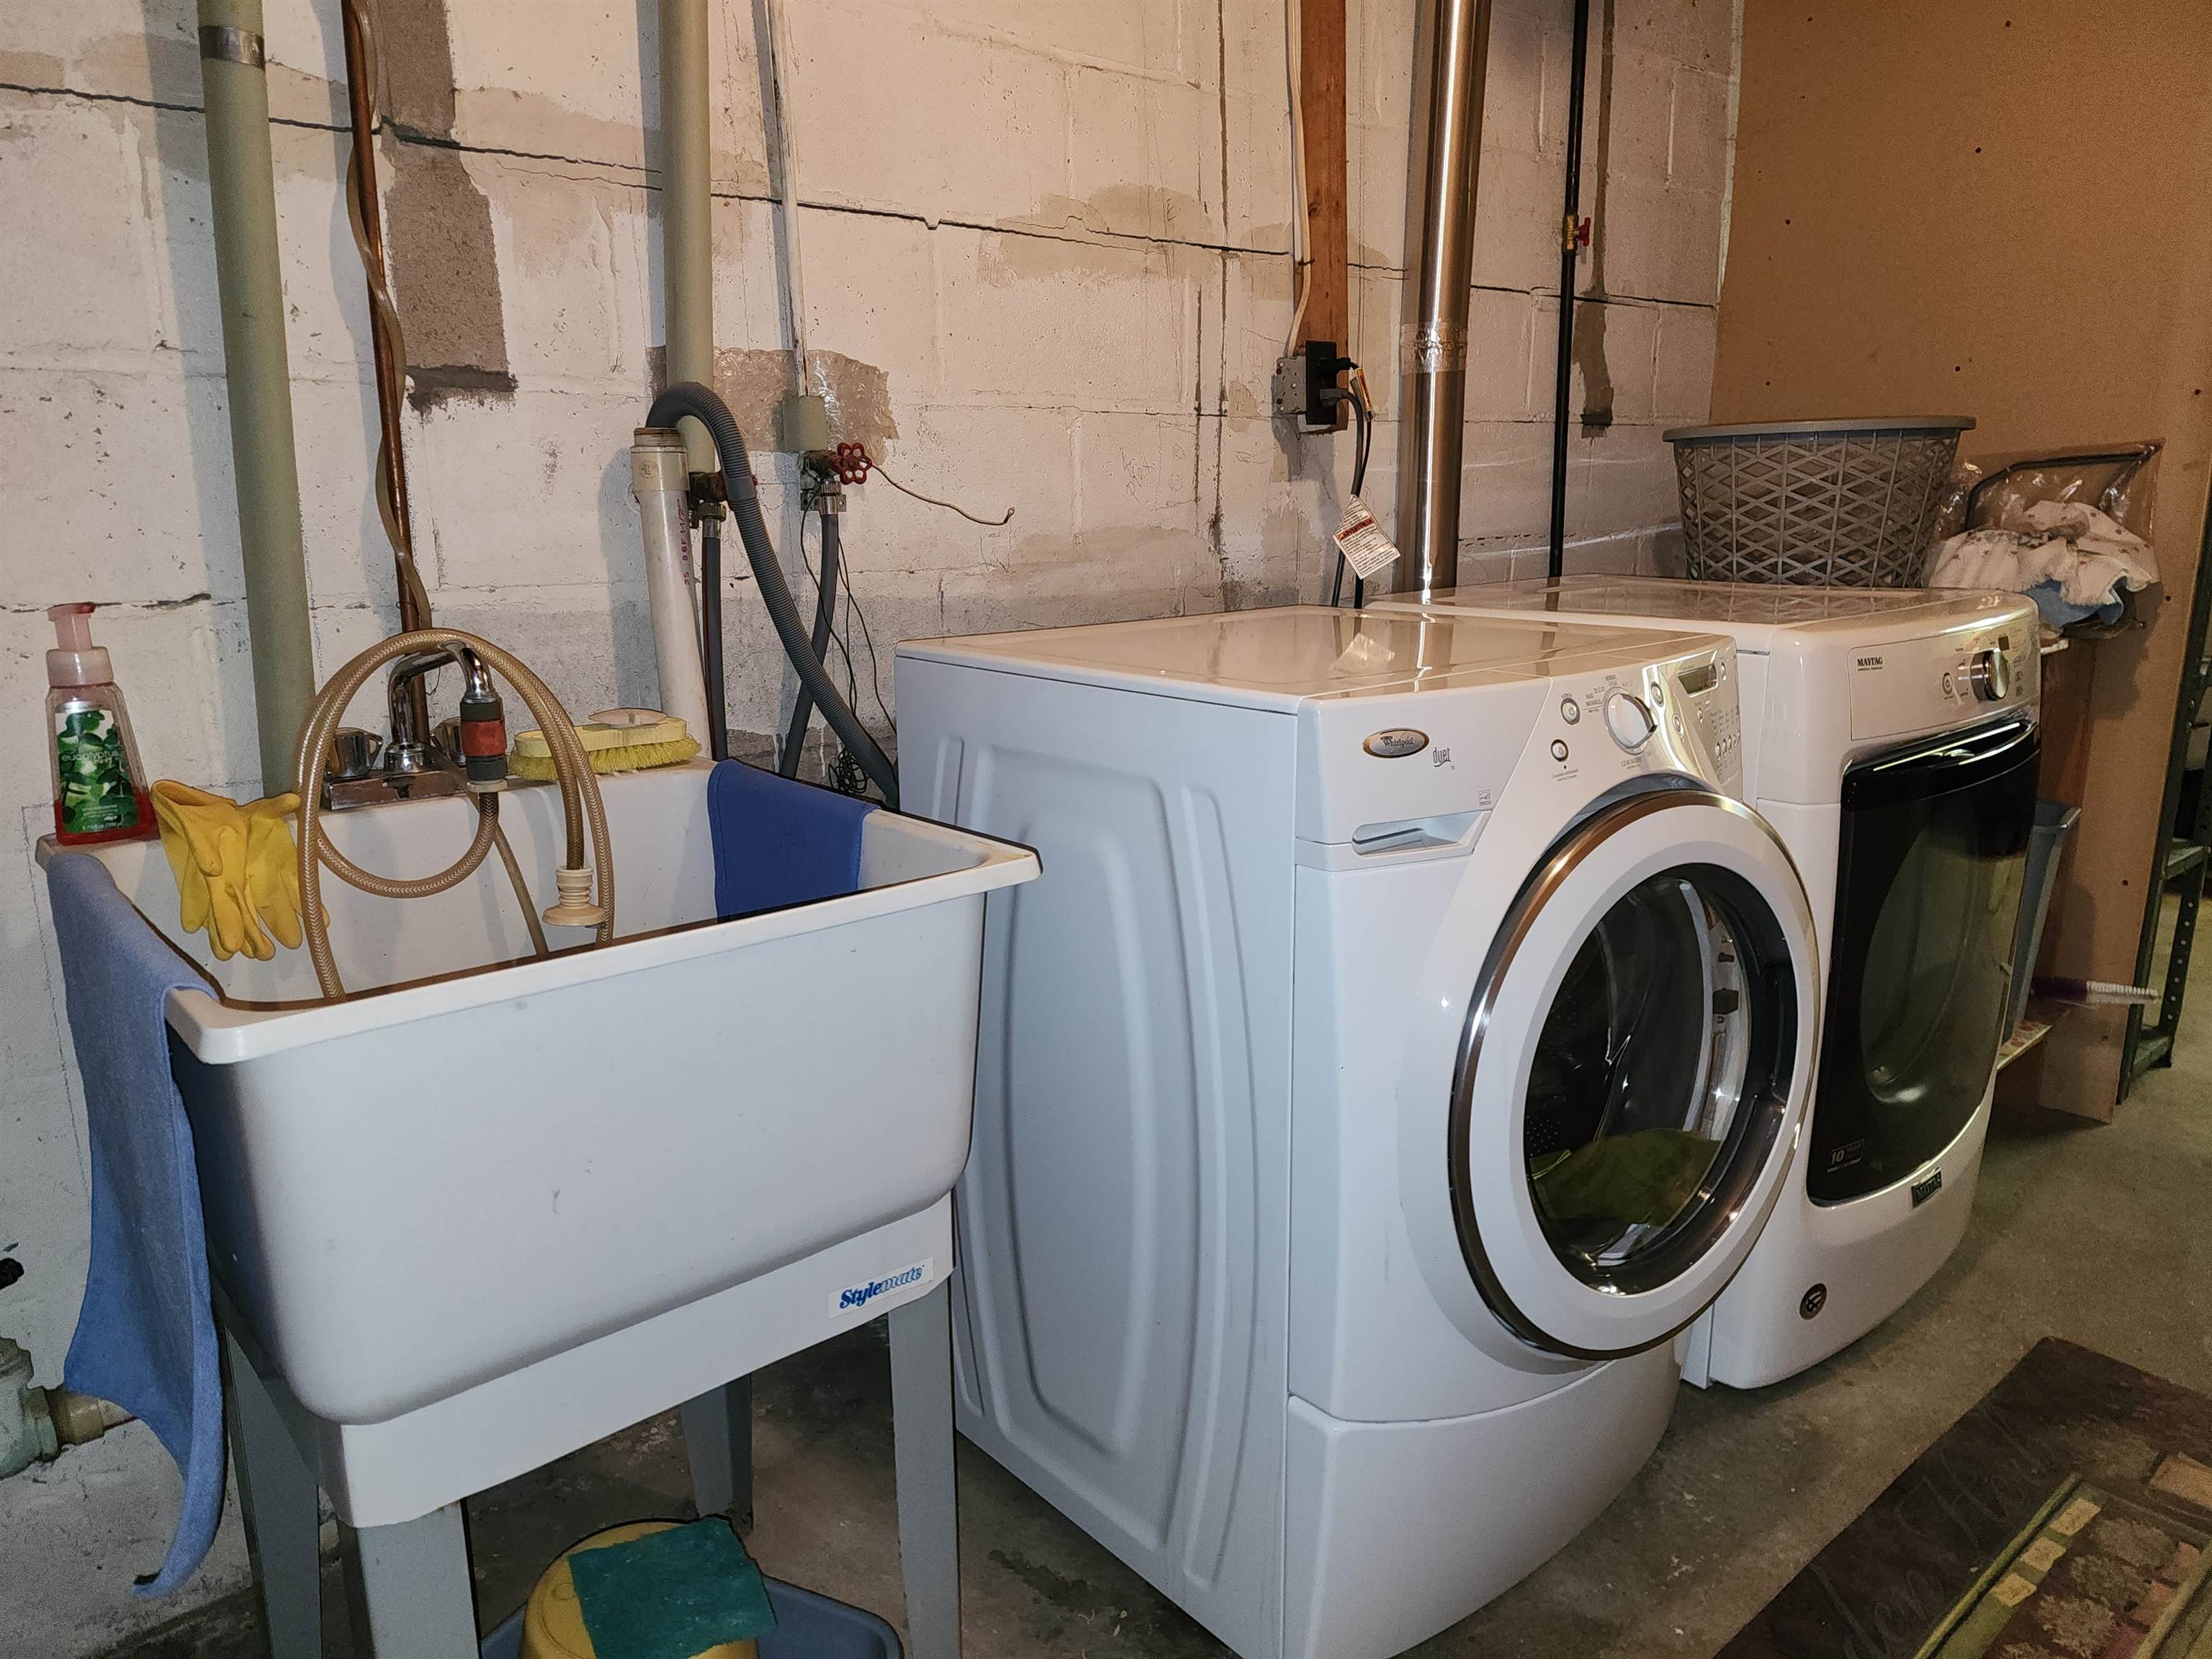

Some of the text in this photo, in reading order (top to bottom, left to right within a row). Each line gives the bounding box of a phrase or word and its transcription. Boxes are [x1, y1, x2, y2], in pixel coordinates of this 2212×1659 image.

[1856, 656, 1883, 667] MAYTAG
[1382, 735, 1415, 748] Whirlpool
[1432, 746, 1452, 767] duet
[1831, 1148, 1845, 1165] 10
